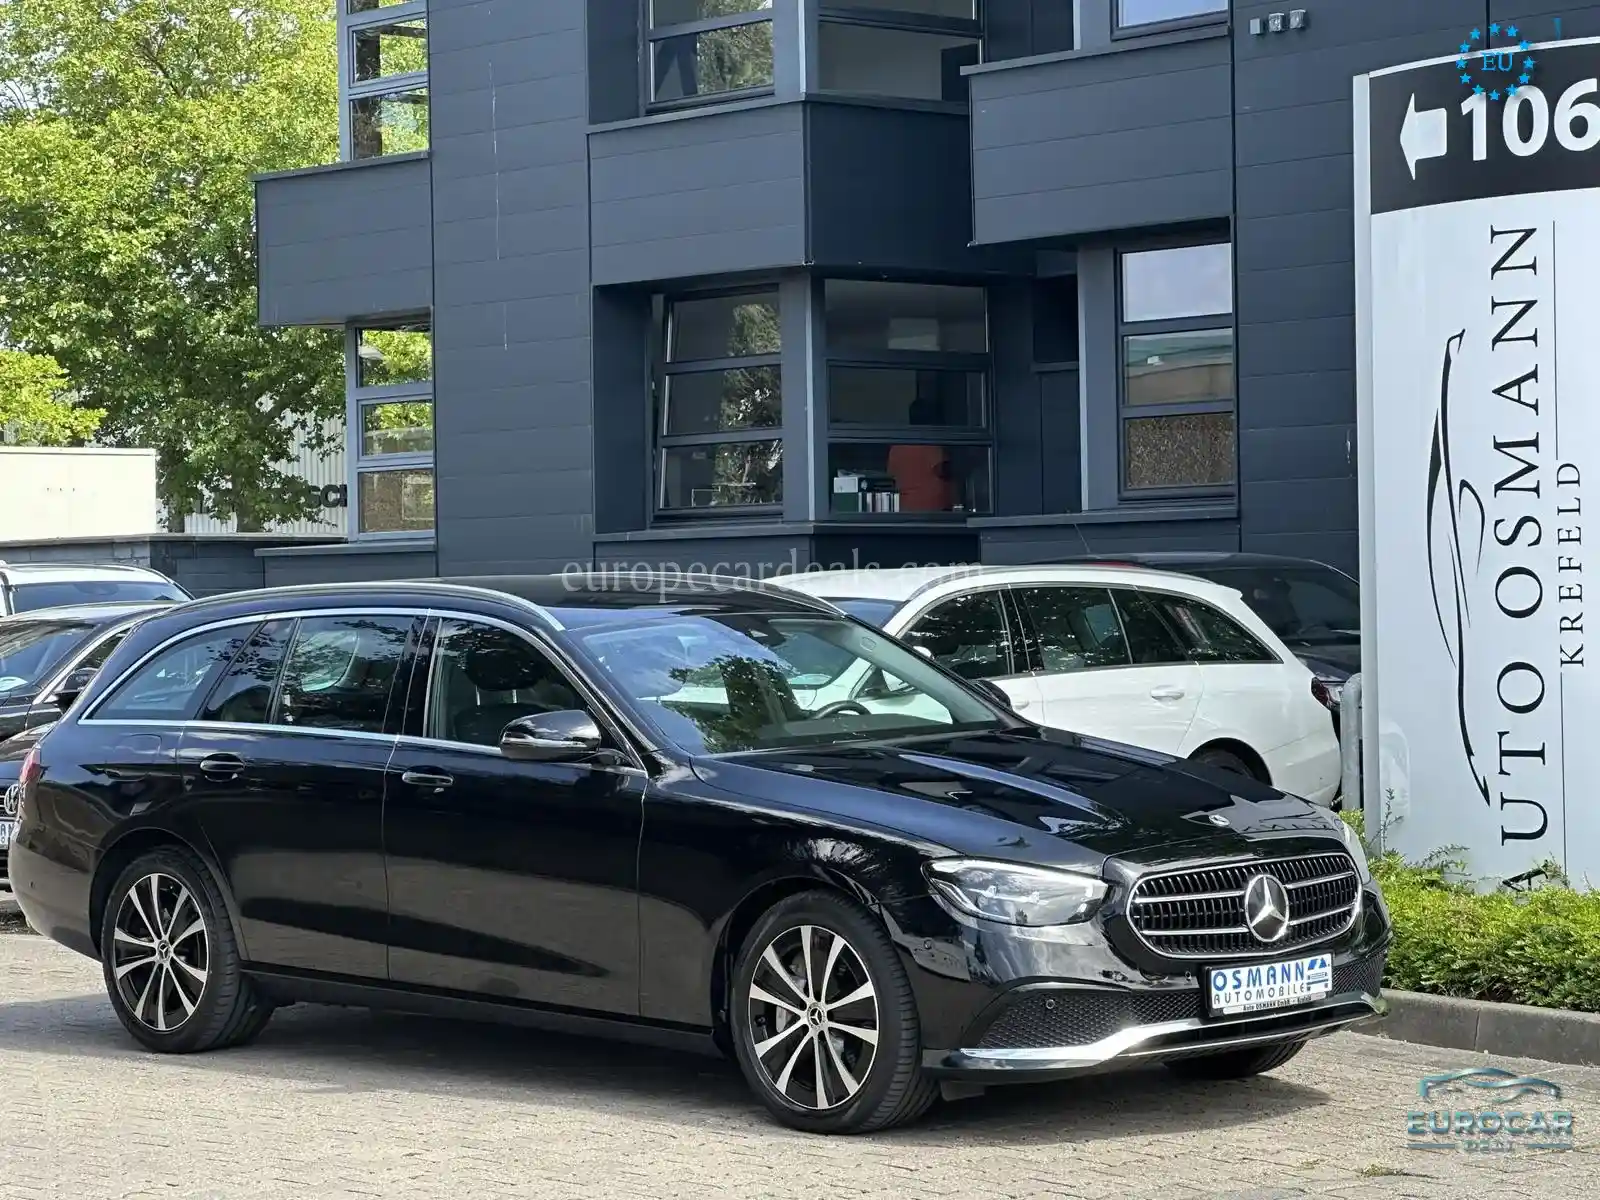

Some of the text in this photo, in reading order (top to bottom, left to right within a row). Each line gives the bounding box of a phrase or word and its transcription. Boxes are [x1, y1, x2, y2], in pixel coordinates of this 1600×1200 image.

[1460, 78, 1600, 161] 106
[1490, 224, 1543, 619] OSMANN
[1556, 463, 1585, 667] KREFELD
[1213, 961, 1304, 991] OSMANN
[1213, 982, 1304, 1005] AUTOMOBILE
